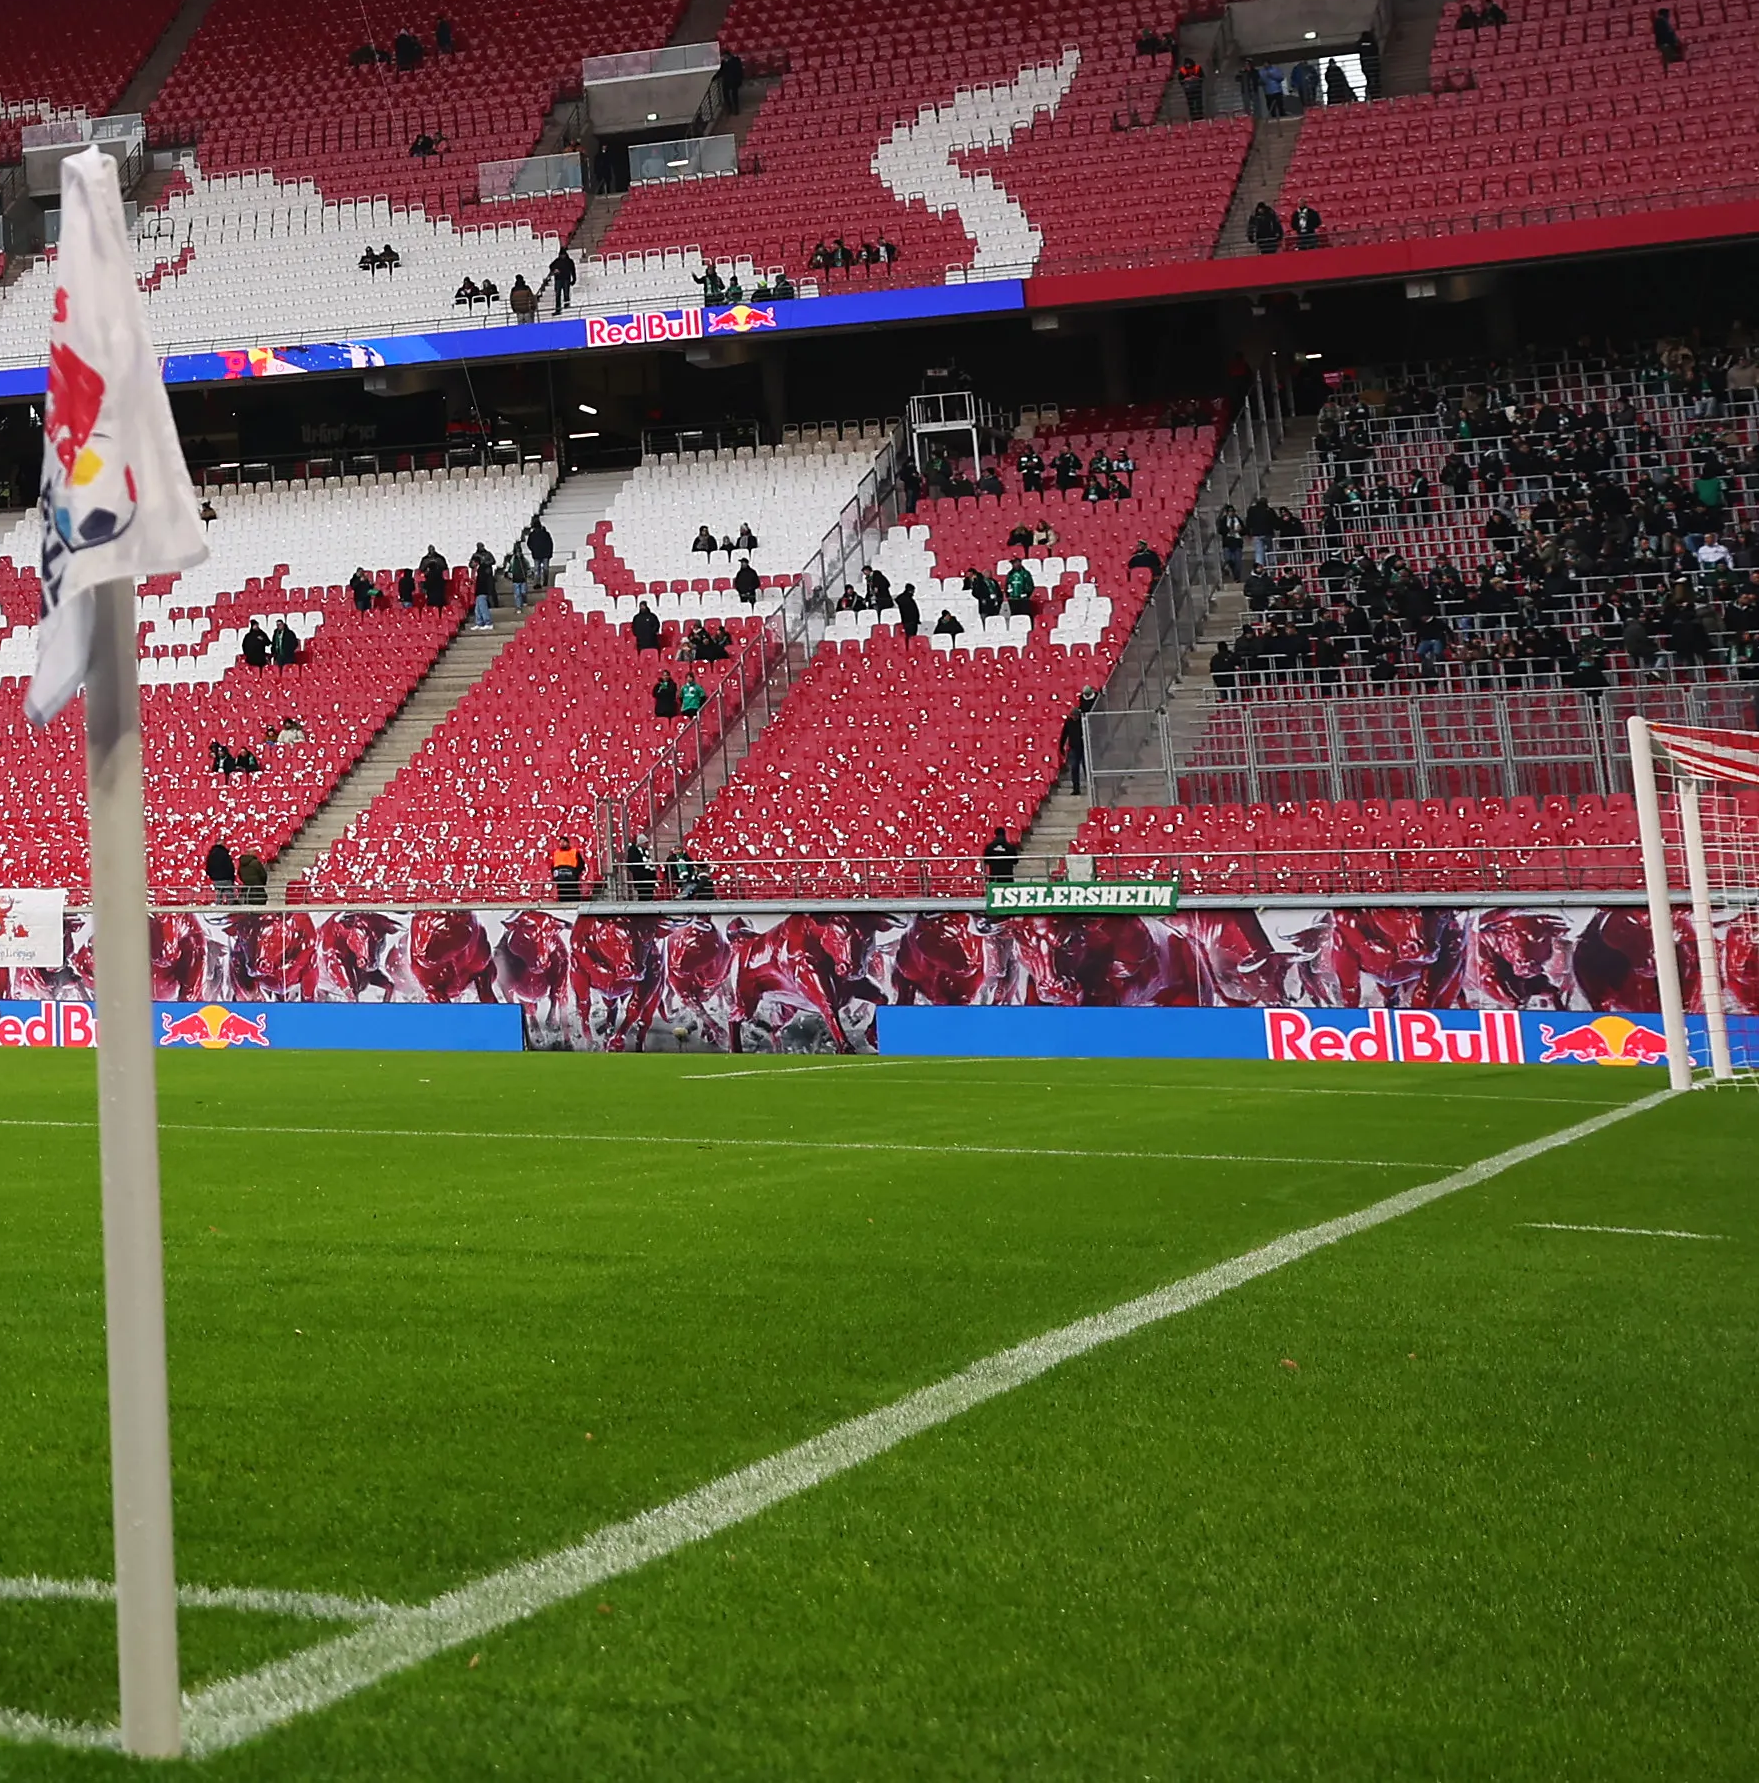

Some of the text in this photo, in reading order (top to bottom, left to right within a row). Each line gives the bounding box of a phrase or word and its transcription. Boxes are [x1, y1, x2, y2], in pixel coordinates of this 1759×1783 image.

[586, 308, 703, 347] Red Bull
[990, 886, 1174, 908] ISELERSHEIM
[1264, 1008, 1525, 1065] Red Bull
